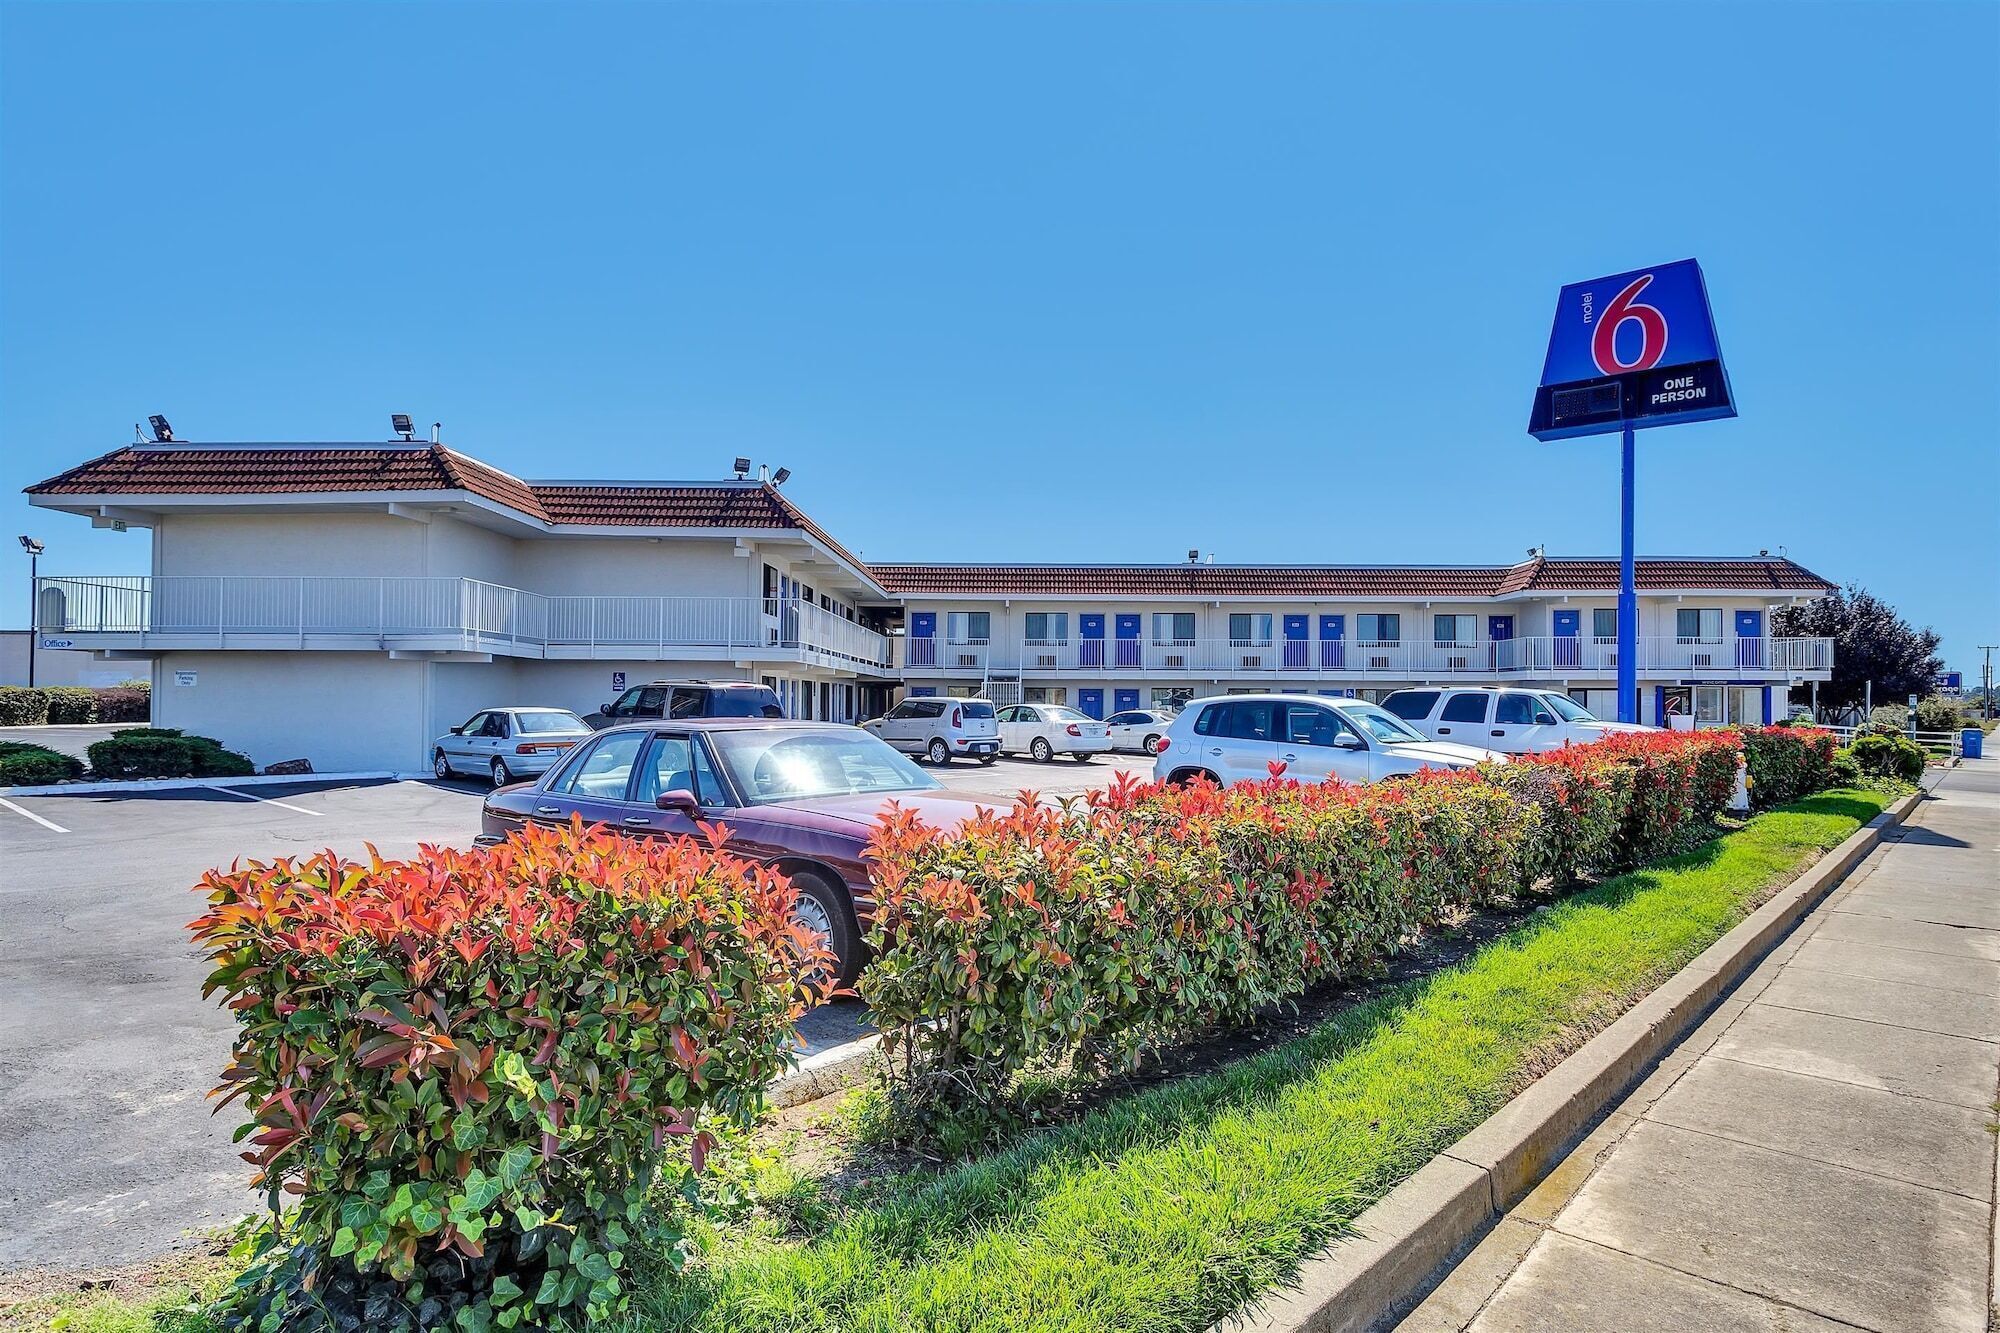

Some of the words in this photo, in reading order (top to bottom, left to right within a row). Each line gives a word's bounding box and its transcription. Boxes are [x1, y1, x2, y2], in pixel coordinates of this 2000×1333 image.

[1582, 292, 1593, 323] motel
[1591, 274, 1668, 375] 6
[1664, 376, 1694, 390] ONE
[1652, 387, 1706, 404] PERSON
[44, 639, 67, 648] Office
